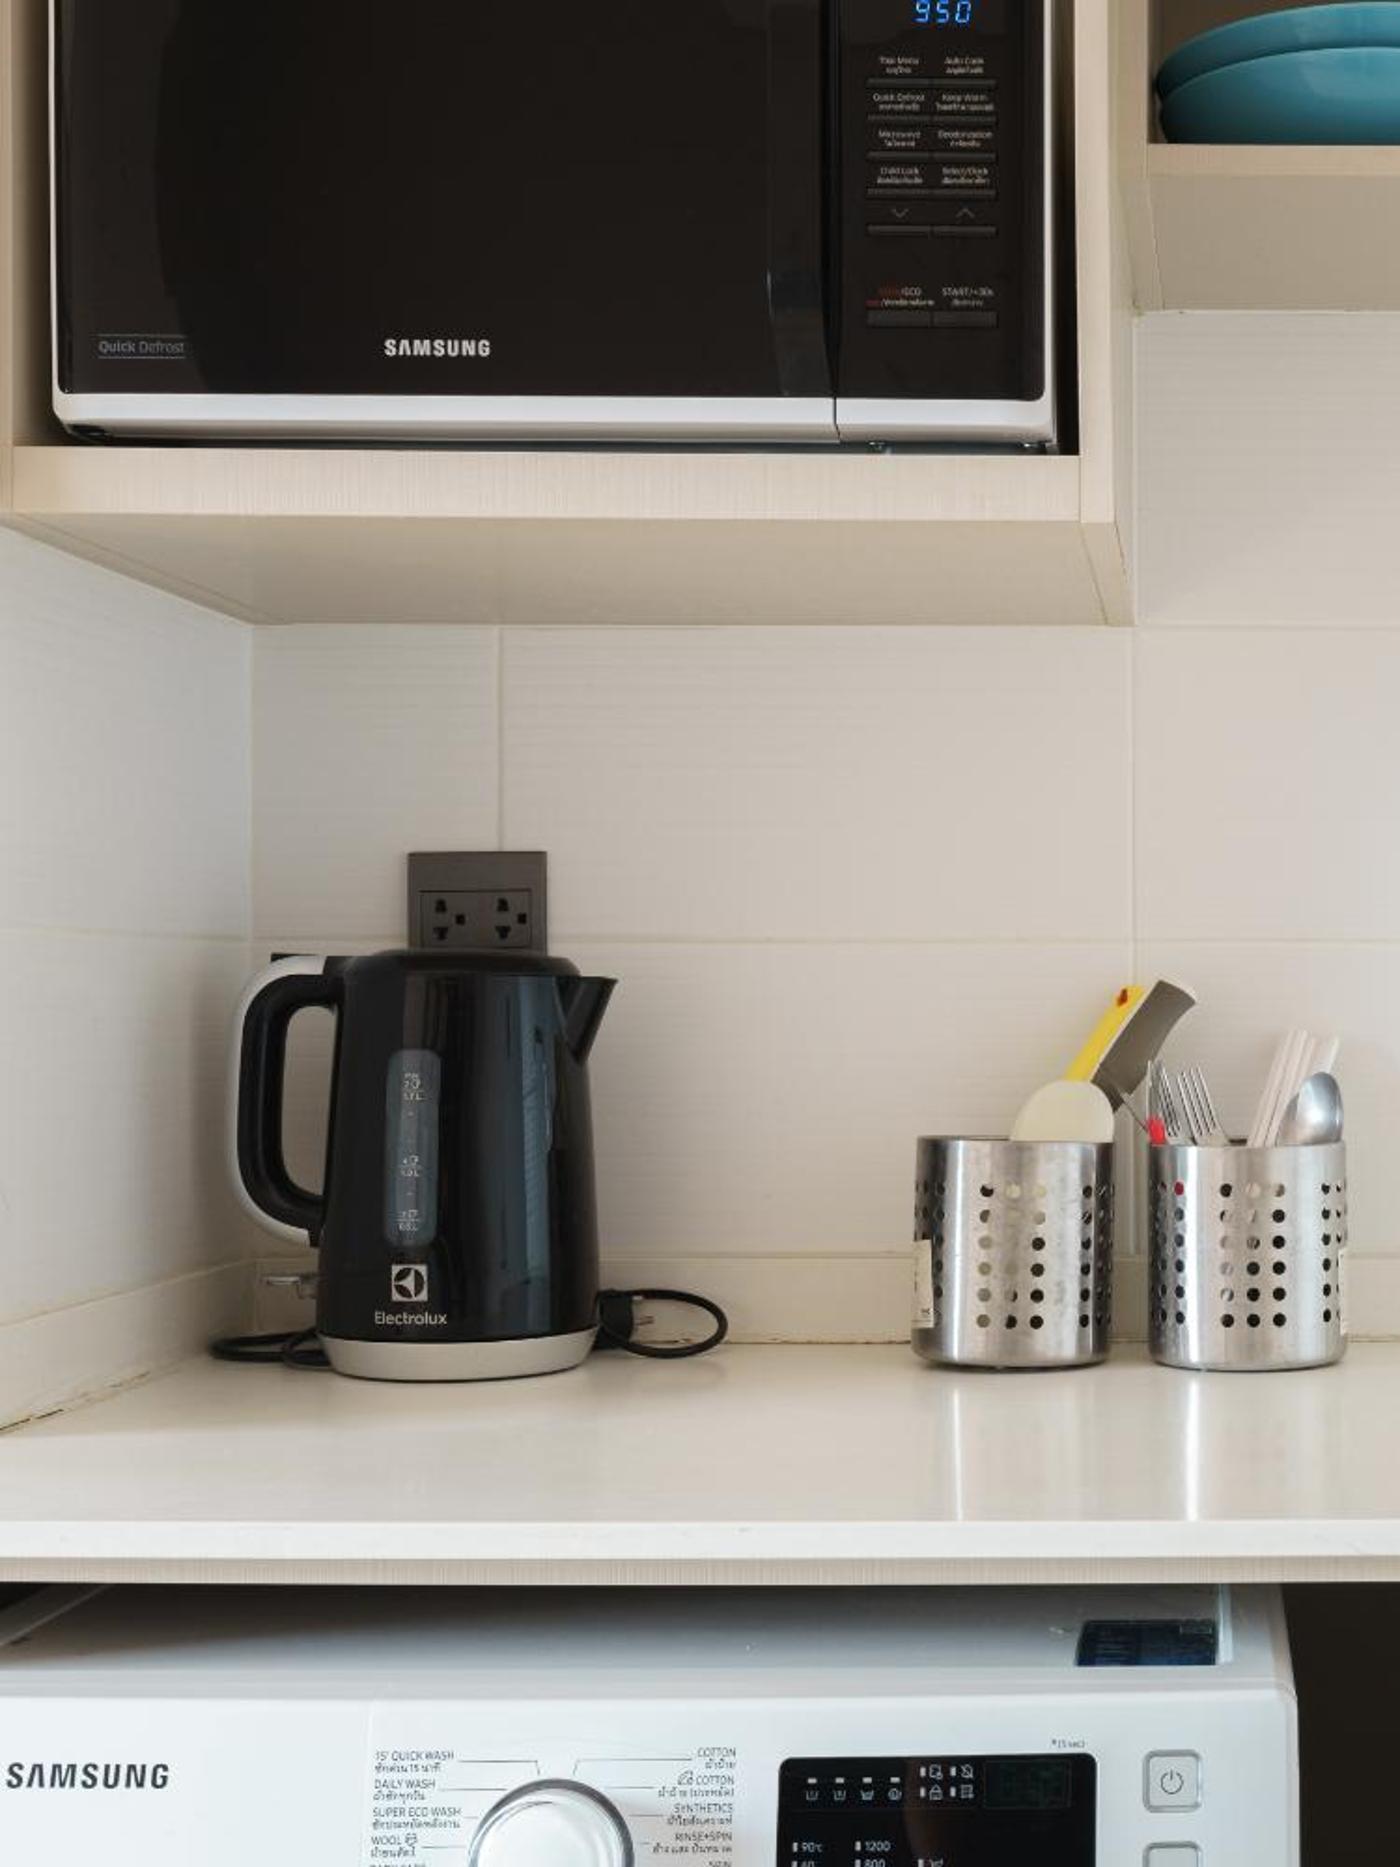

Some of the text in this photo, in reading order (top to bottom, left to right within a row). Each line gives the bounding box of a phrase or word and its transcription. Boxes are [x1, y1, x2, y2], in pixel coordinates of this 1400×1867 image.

[944, 56, 964, 64] Auto
[872, 93, 925, 102] Quick Defrost
[901, 167, 919, 175] Lock
[99, 340, 184, 354] Quick Defrost
[384, 338, 491, 357] SAMSUNG
[375, 1311, 447, 1326] Electrolux
[391, 1750, 422, 1761] QUICK
[424, 1750, 454, 1761] WASH
[697, 1747, 736, 1758] COTTON
[6, 1762, 169, 1789] SAMSUNG
[695, 1775, 735, 1785] COTTON
[374, 1779, 436, 1789] DAILY WASH
[373, 1807, 461, 1817] SUPER ECO WASH
[673, 1803, 733, 1813] SYNTHETICS
[371, 1835, 401, 1845] WOOL
[675, 1831, 733, 1841] RINSE+SPIN
[865, 1841, 891, 1851] 1200
